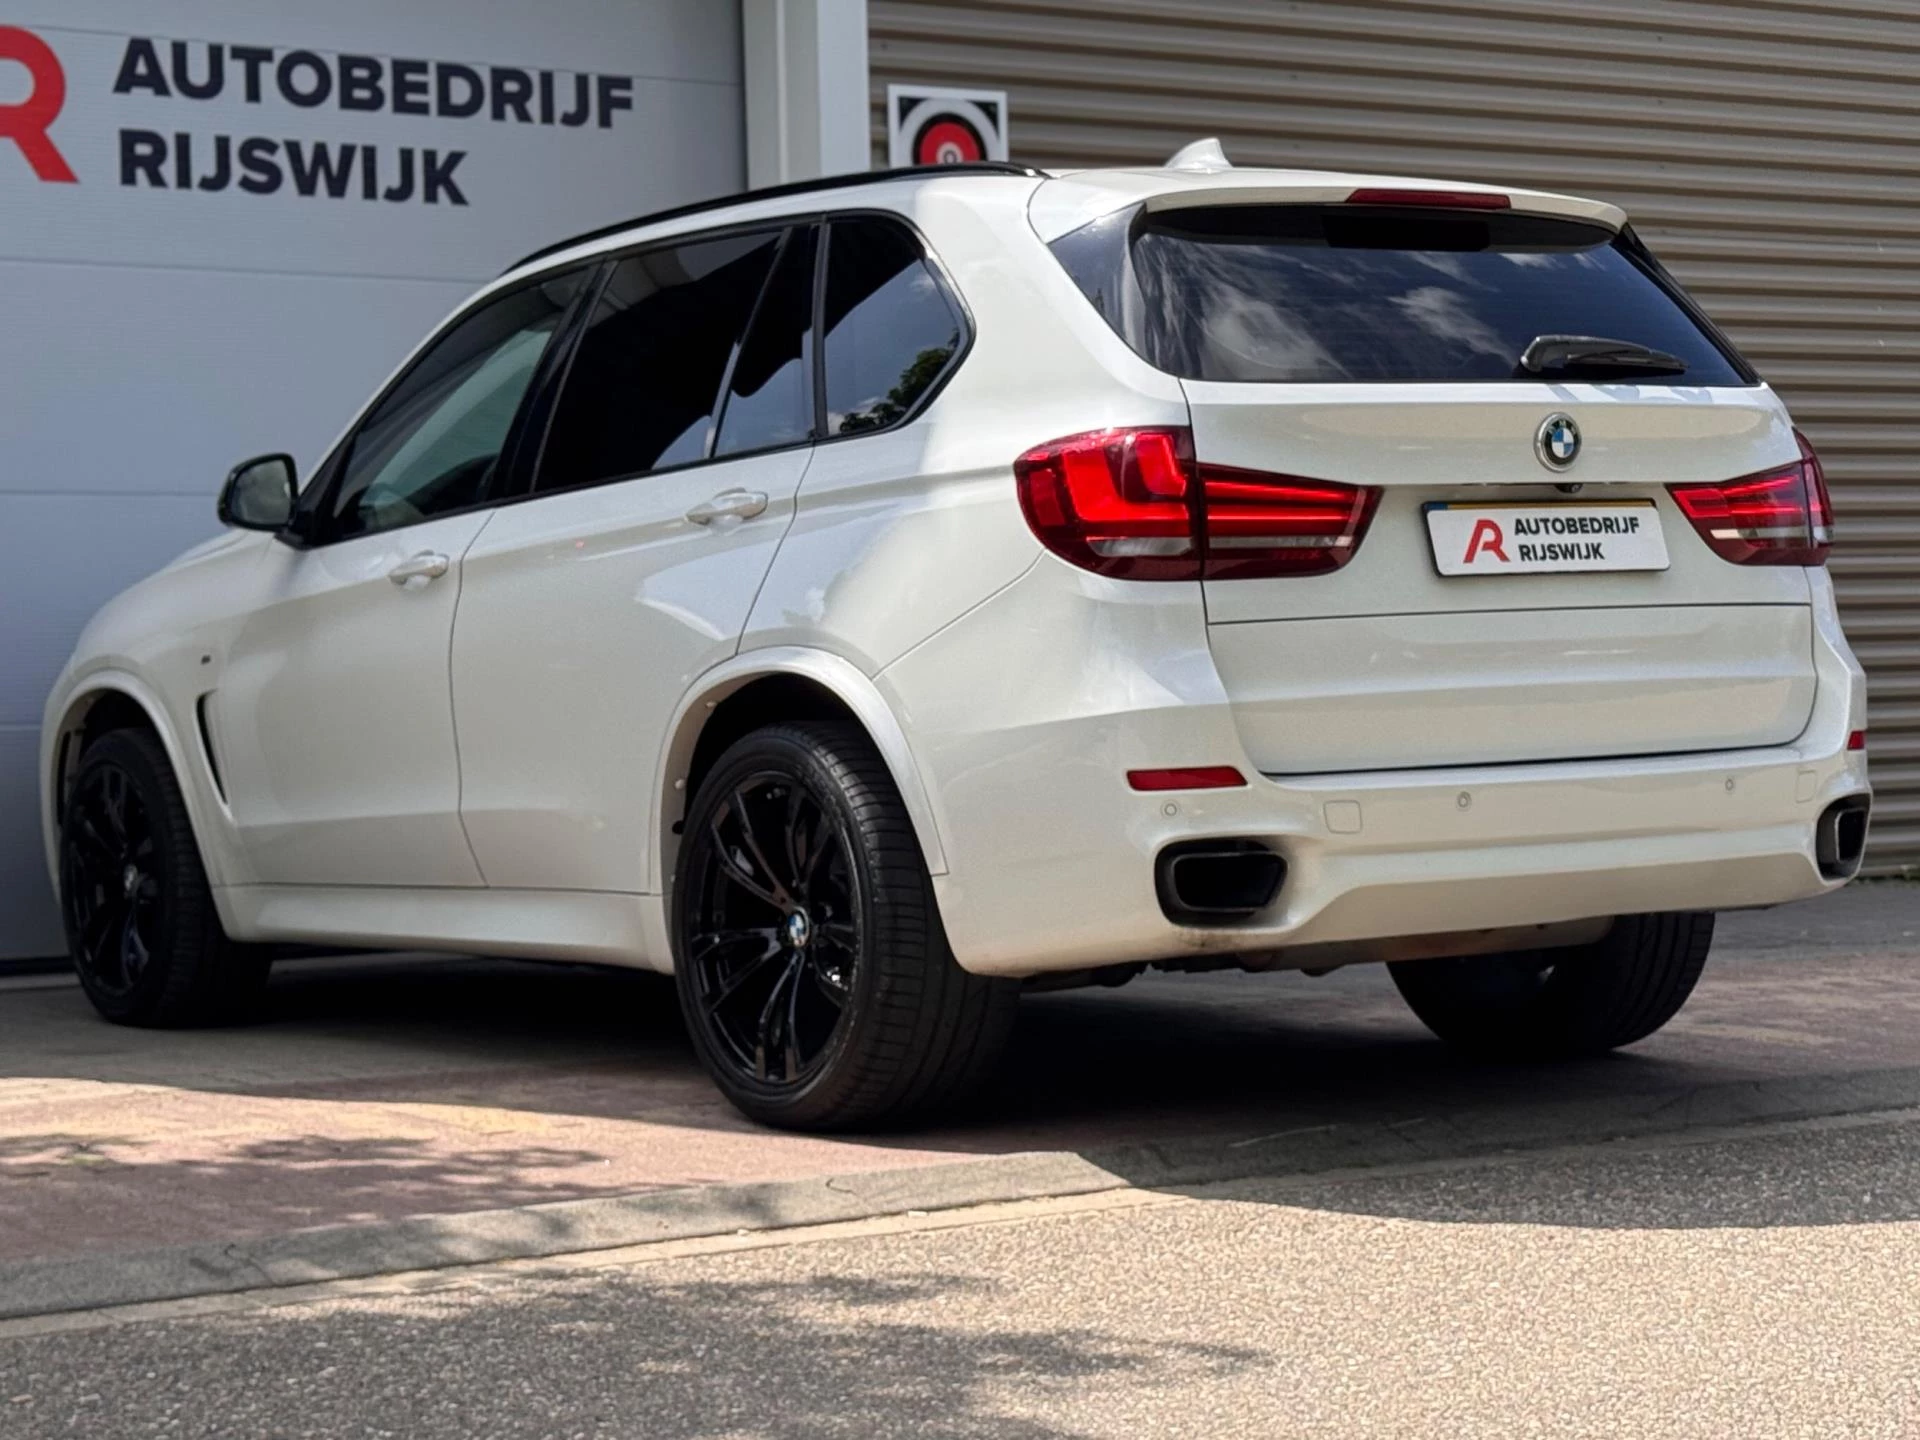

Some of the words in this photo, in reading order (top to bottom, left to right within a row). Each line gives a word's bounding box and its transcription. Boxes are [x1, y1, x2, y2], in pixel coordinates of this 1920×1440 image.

[112, 36, 634, 130] AUTOBEDRIJF
[118, 128, 470, 207] RIJSWIJK
[1514, 516, 1640, 536] AUTOBEDRIJF
[1518, 542, 1605, 563] RIJSWIJK
